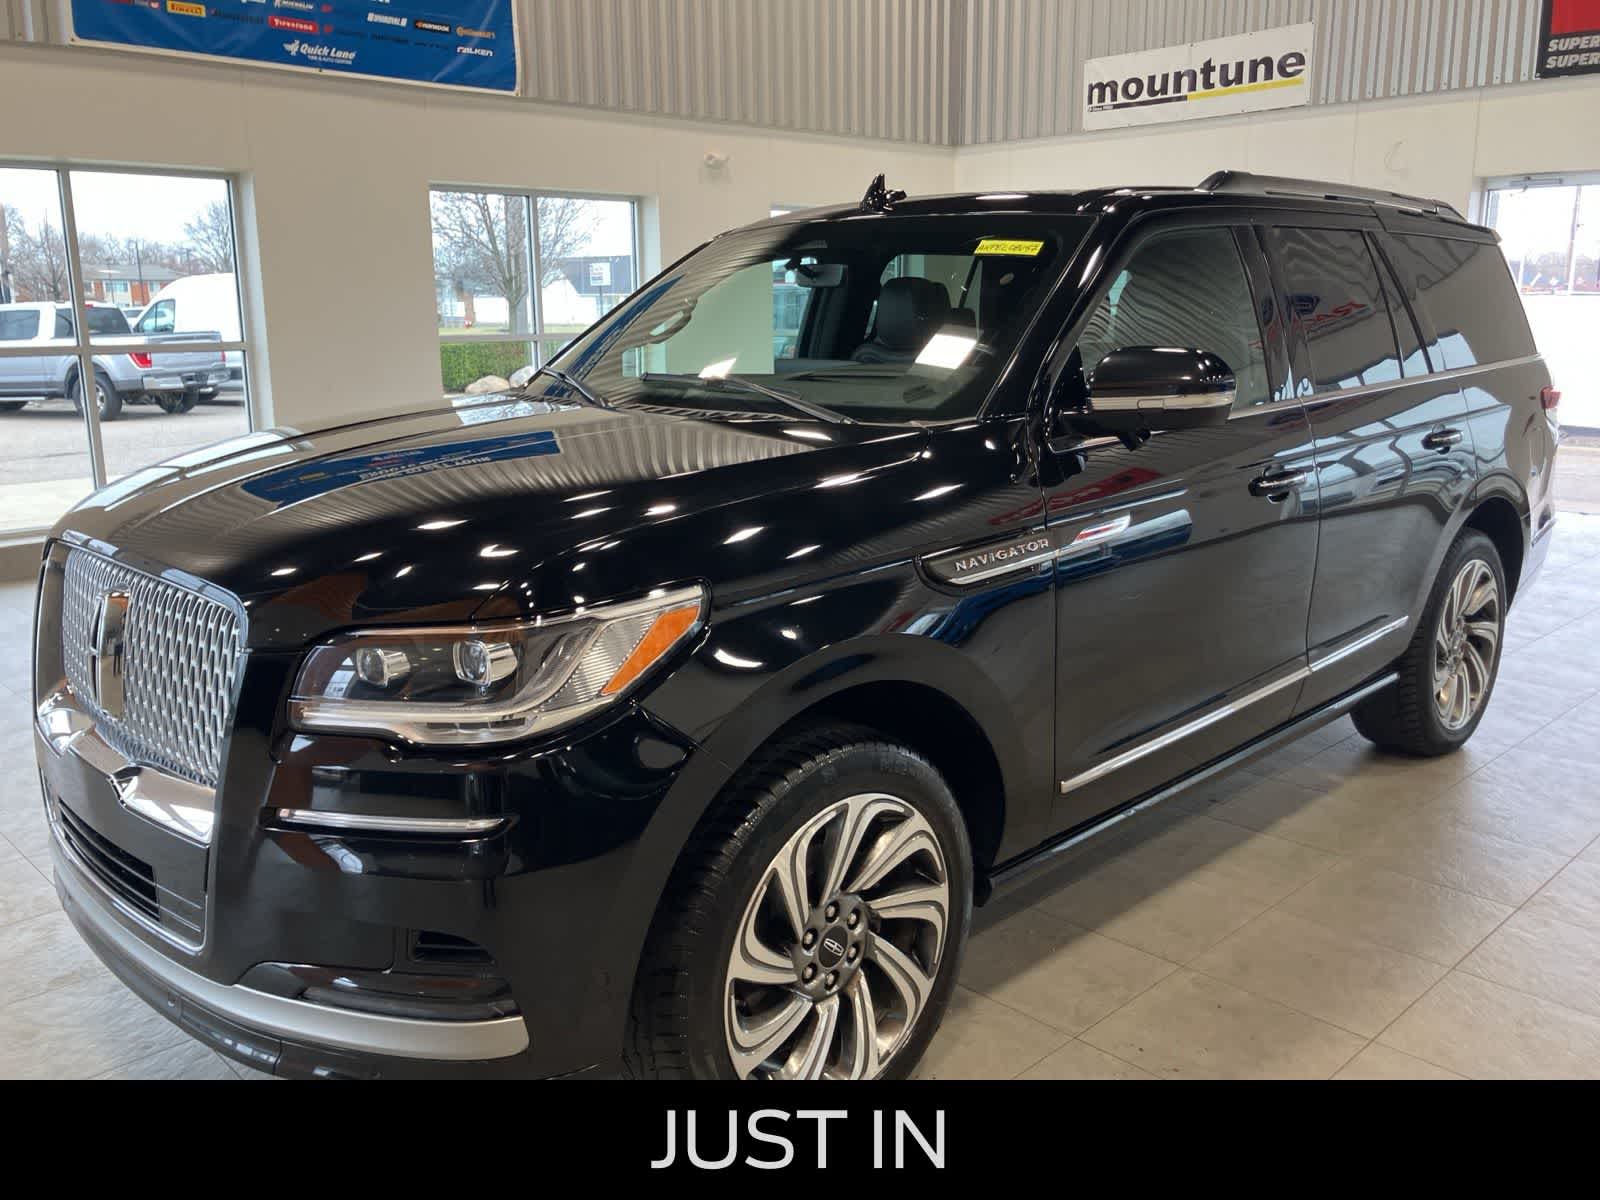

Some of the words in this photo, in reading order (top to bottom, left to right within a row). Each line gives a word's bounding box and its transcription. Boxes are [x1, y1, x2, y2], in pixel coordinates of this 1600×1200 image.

[300, 43, 330, 57] Quick
[330, 47, 357, 59] Lane
[1087, 51, 1306, 105] mountune
[955, 538, 1049, 571] NAVIGATOR
